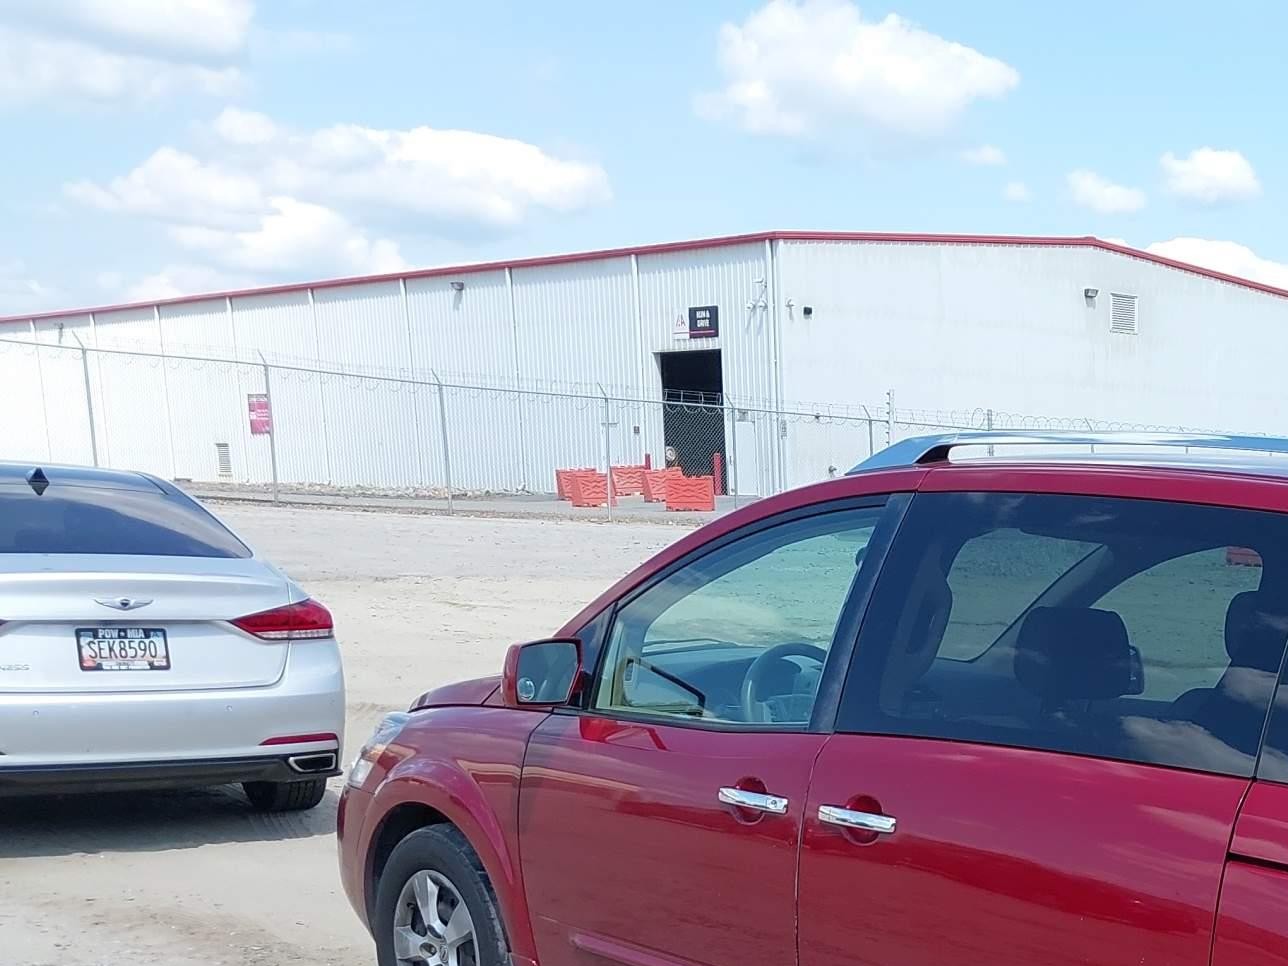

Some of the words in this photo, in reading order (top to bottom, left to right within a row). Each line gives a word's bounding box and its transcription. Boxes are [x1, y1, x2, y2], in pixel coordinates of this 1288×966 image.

[98, 628, 118, 639] POW
[127, 628, 145, 639] MIA
[87, 640, 158, 660] SEK8590
